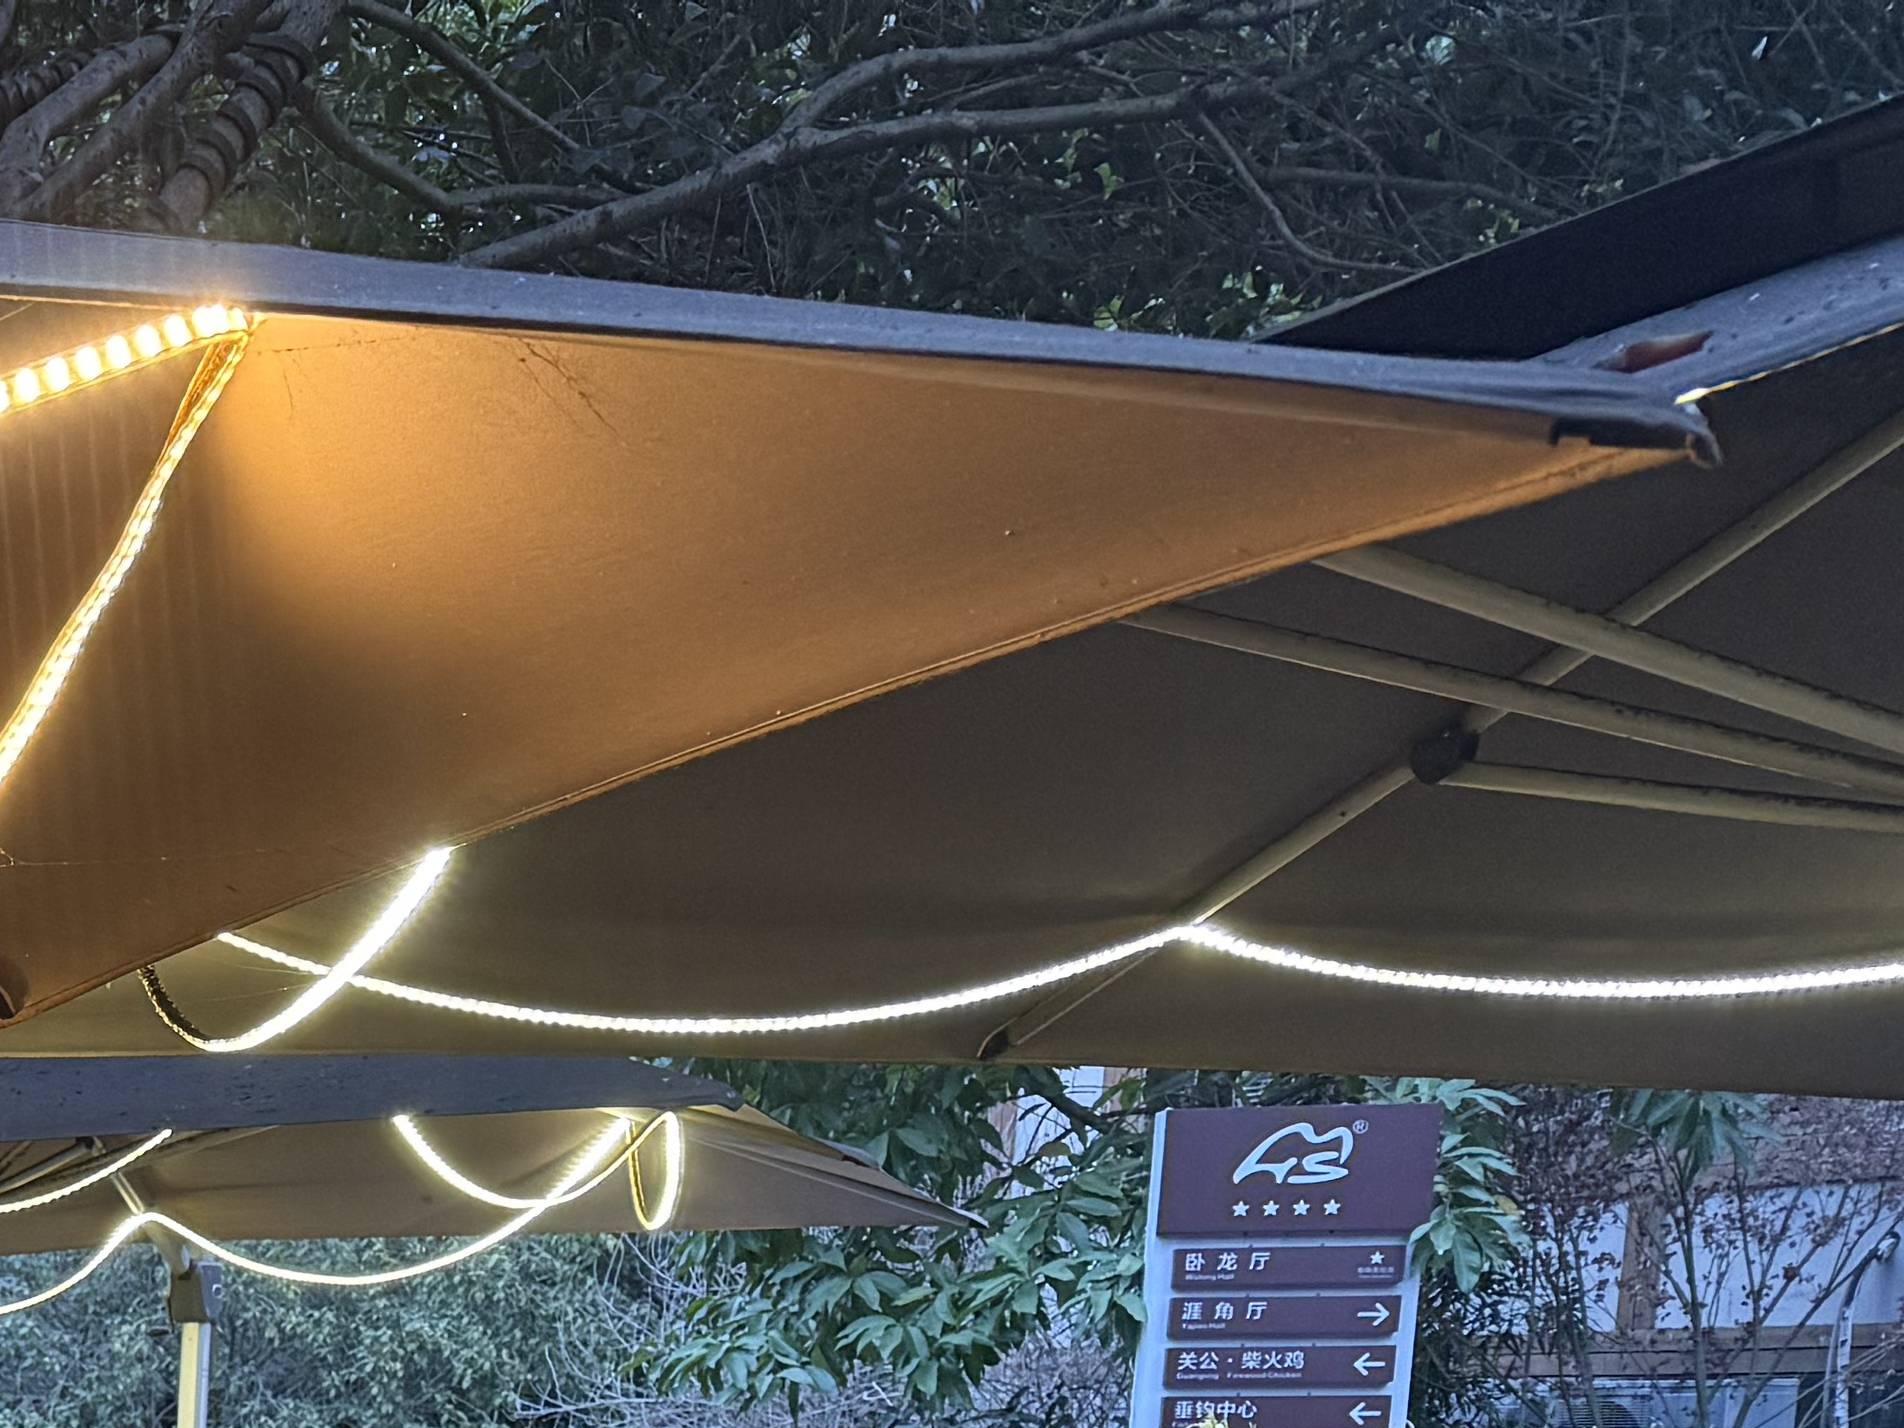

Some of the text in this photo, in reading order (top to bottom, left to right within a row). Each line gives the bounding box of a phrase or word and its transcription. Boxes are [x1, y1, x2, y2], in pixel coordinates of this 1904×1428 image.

[1185, 1252, 1270, 1271] 卧龙厅
[1181, 1302, 1267, 1320] 涯角厅
[1174, 1400, 1258, 1419] 垂钓中心
